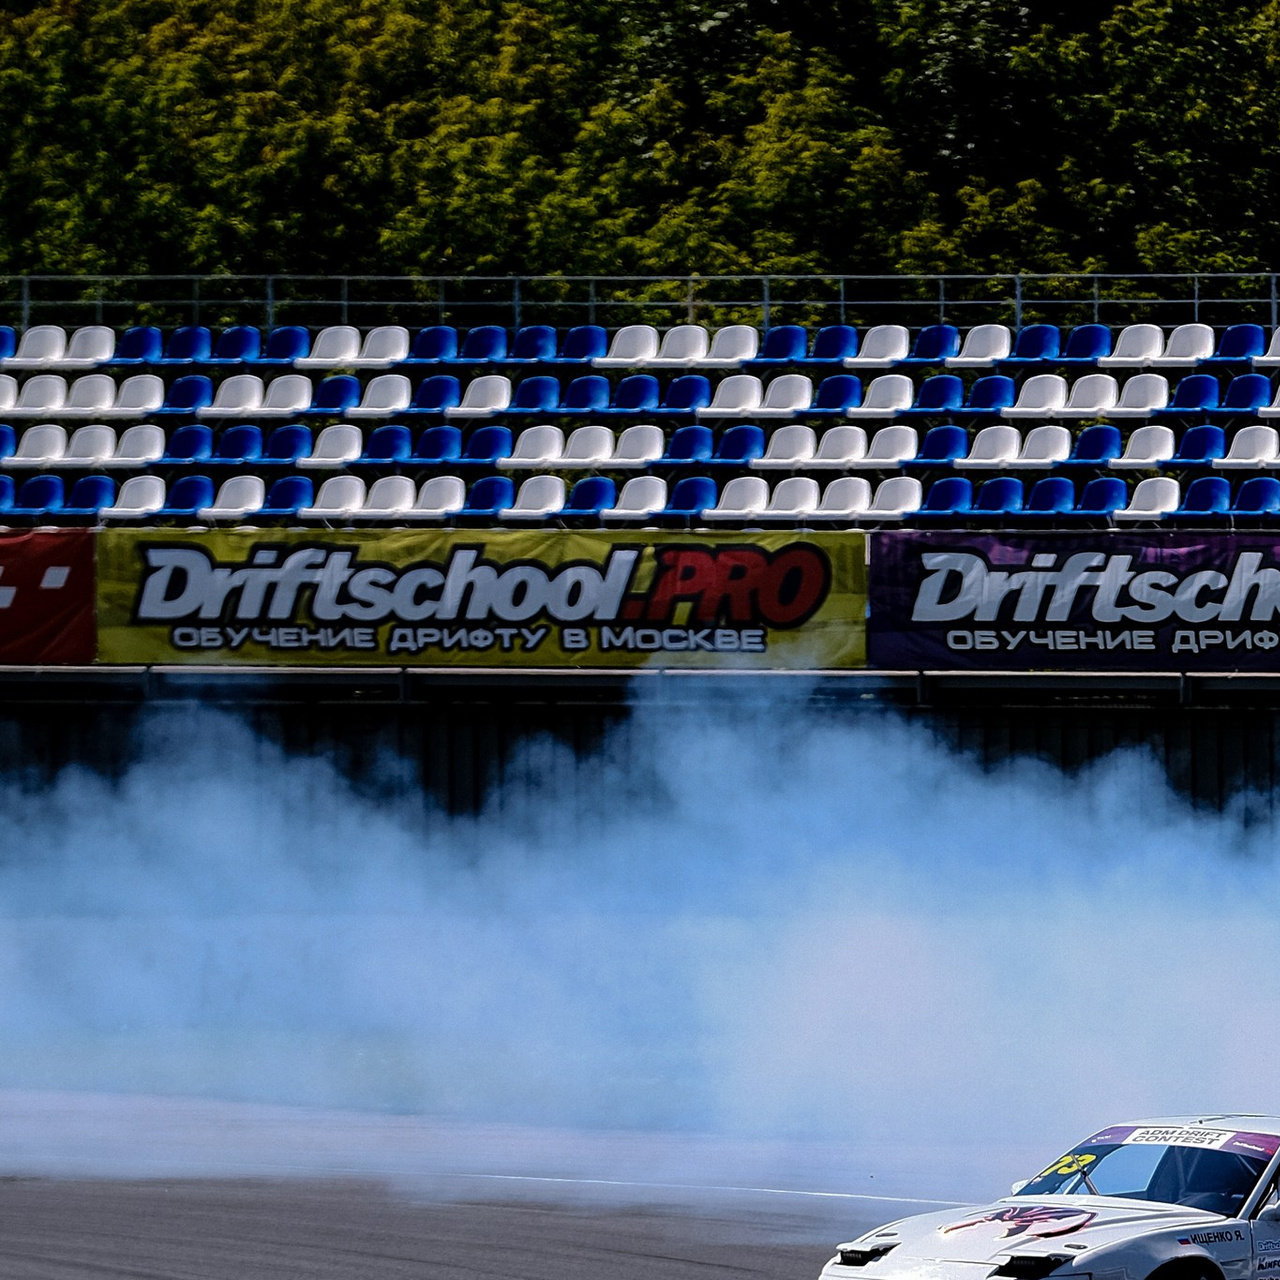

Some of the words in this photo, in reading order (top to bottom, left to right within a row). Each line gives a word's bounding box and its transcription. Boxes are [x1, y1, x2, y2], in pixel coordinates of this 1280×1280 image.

[138, 547, 826, 627] Driftschool.PRO
[173, 627, 375, 649] ОБУЧЕНИЕ
[390, 627, 544, 651] ДРИФТУ
[563, 628, 590, 649] В
[602, 627, 765, 652] МОСКВЕ
[946, 629, 1156, 651] ОБУЧЕНИЕ
[1132, 1135, 1220, 1146] CONTEST
[1139, 1129, 1178, 1137] ADM
[1179, 1130, 1227, 1139] DRIFT
[1190, 1231, 1233, 1245] ИЩЕНКО
[1235, 1230, 1245, 1241] Я.
